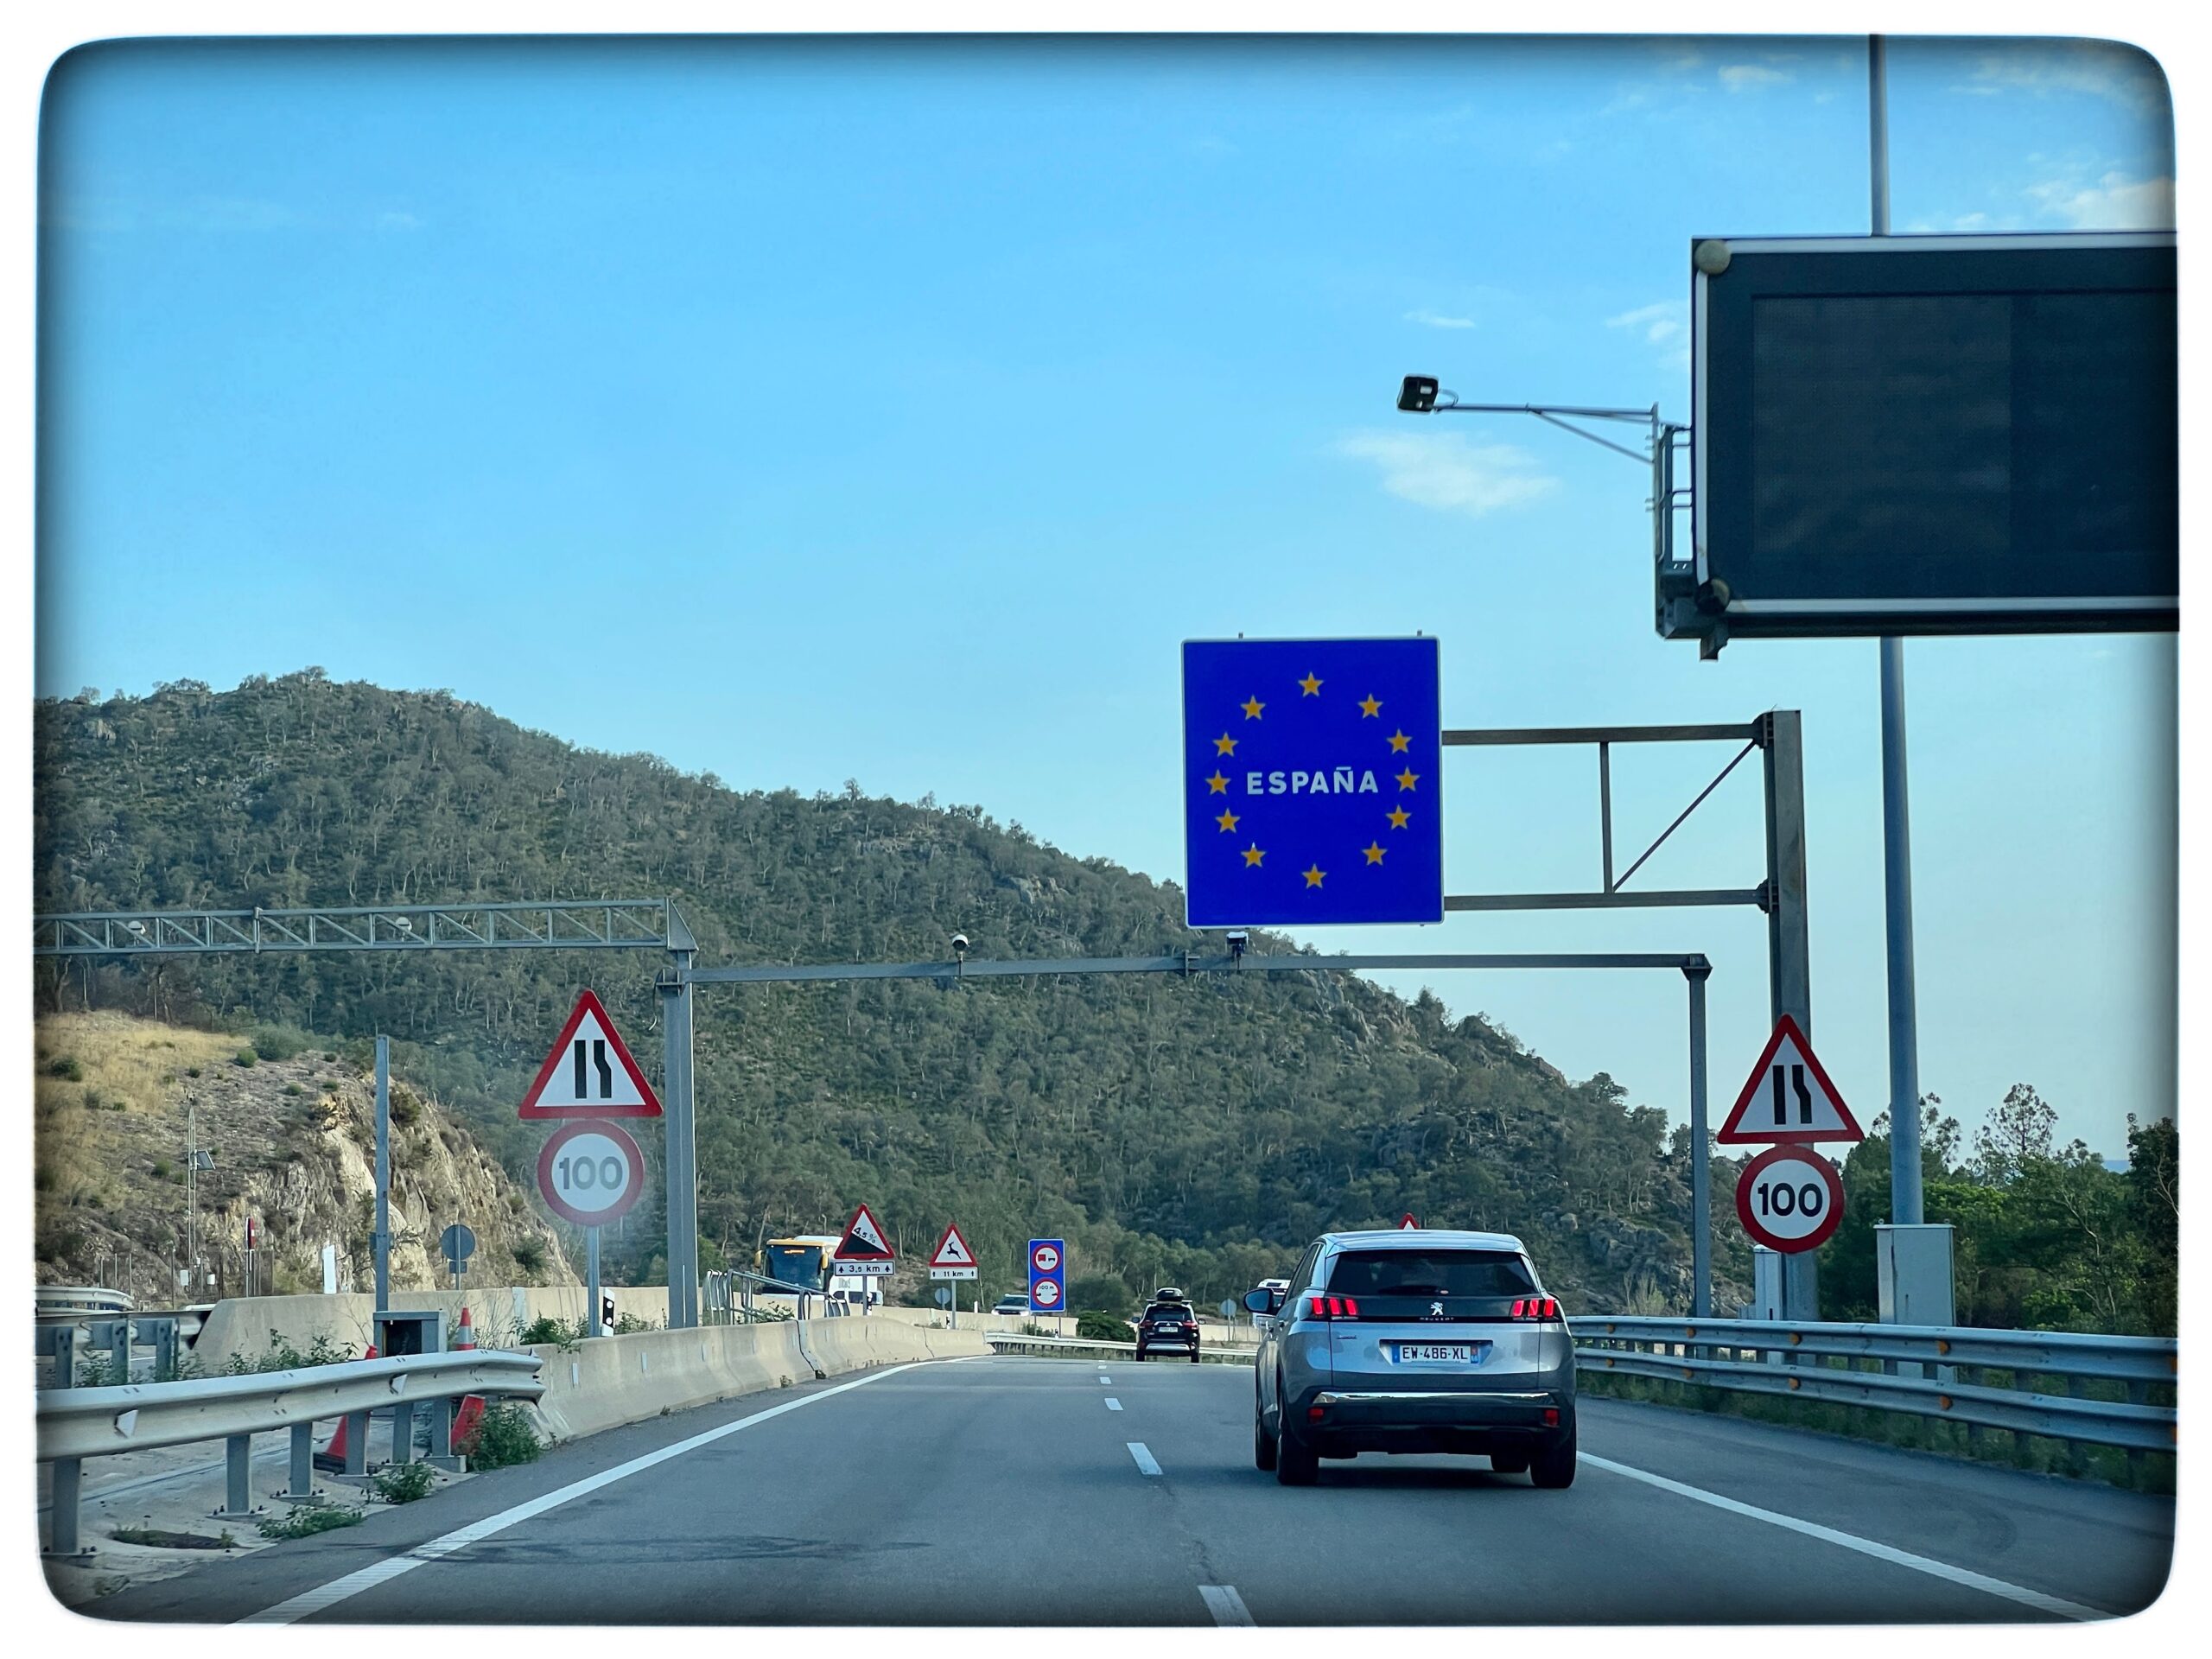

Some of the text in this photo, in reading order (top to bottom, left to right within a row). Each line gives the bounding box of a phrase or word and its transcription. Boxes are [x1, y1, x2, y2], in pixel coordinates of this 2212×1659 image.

[1247, 766, 1378, 795] ESPAÑA
[559, 1155, 623, 1191] 100
[1758, 1182, 1823, 1217] 100
[866, 1264, 880, 1273] km
[1402, 1347, 1468, 1360] EW-486-XL
